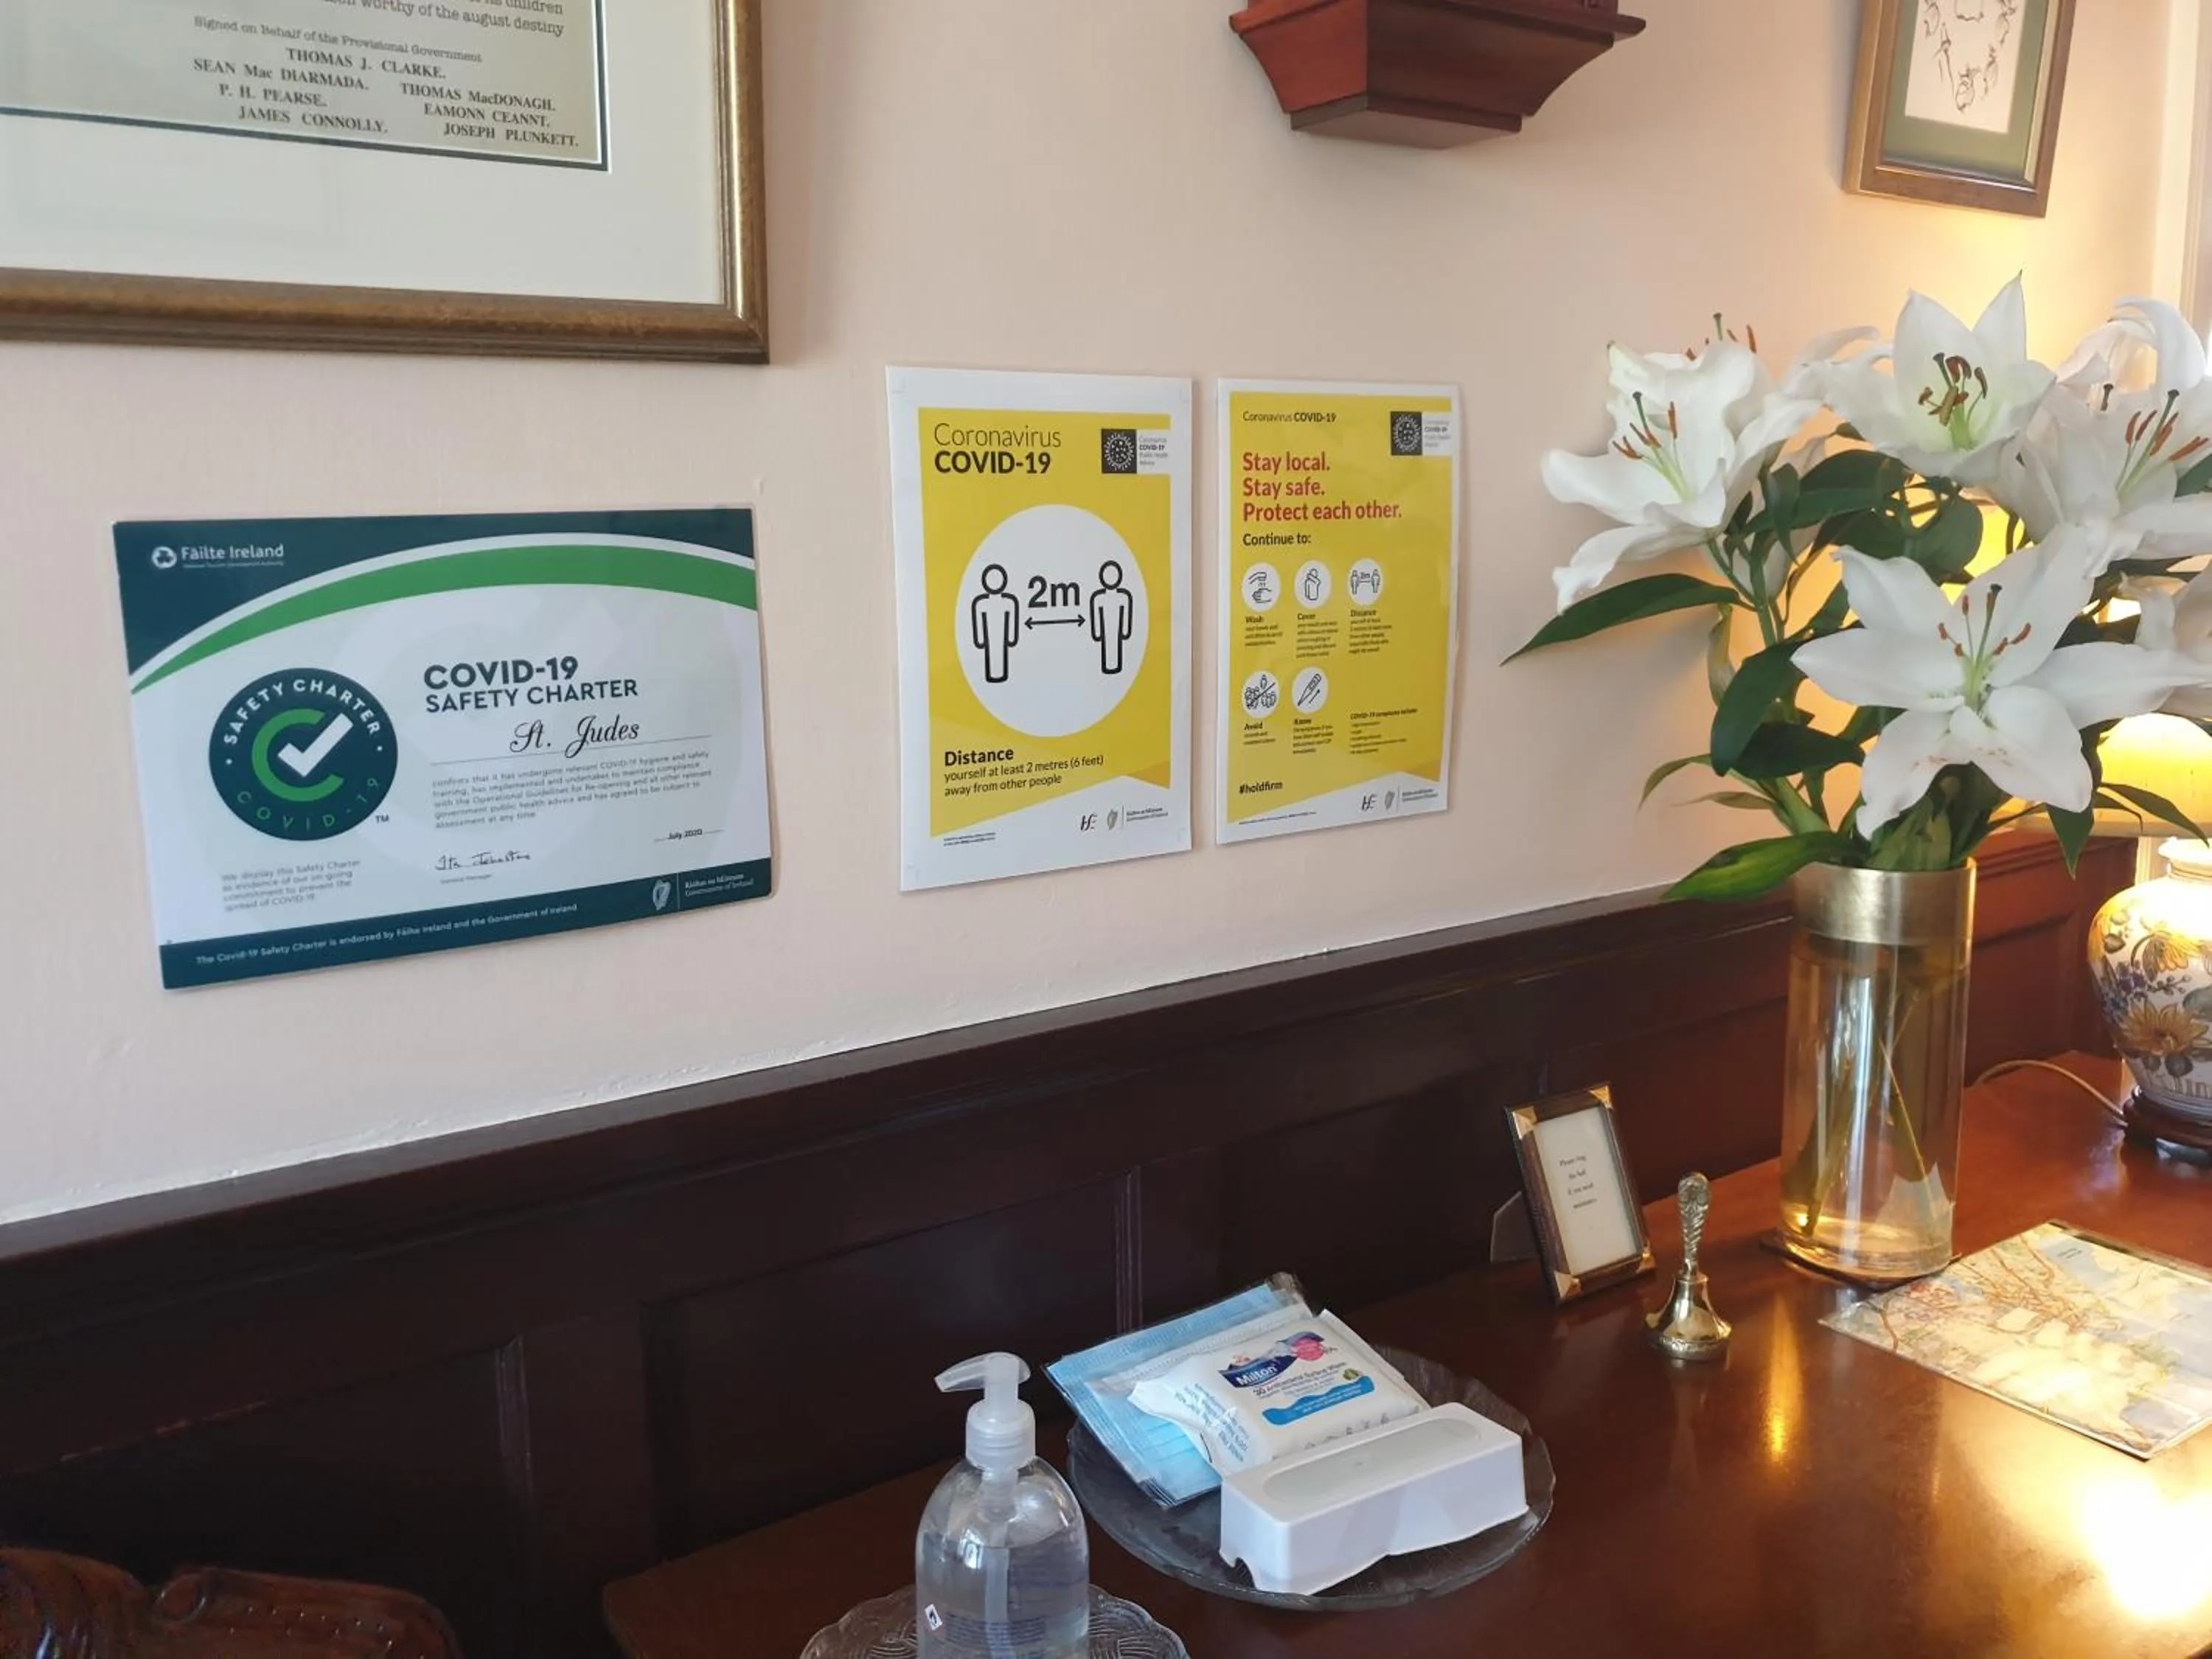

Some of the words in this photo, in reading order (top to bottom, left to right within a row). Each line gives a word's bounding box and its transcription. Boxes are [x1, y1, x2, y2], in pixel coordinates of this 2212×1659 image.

[418, 5, 434, 16] of
[436, 7, 459, 21] the
[463, 12, 510, 27] august
[514, 16, 564, 37] destiny
[195, 15, 237, 31] Signed
[240, 24, 257, 34] on
[342, 35, 408, 54] Provisional
[194, 58, 235, 74] SEAN
[244, 64, 272, 79] Mac
[282, 69, 369, 90] DIARMADA.
[286, 47, 353, 67] THOMAS
[359, 58, 372, 70] J.
[382, 60, 446, 79] CLARKE.
[219, 83, 232, 97] P.
[240, 85, 256, 99] H.
[263, 88, 327, 107] PEARSE.
[401, 83, 462, 100] THOMAS
[469, 90, 555, 111] MacDONAGH.
[239, 106, 290, 123] JAMES
[302, 114, 389, 133] CONNOLLY.
[424, 103, 485, 120] EAMONN
[493, 111, 550, 128] CEANNT.
[444, 122, 495, 139] JOSEPH
[506, 129, 579, 147] PLUNKETT.
[1242, 411, 1292, 422] Coronavirus
[1294, 412, 1336, 422] COVID-19
[933, 422, 1062, 447] Coronavirus
[934, 451, 1051, 474] COVID-19
[1242, 451, 1281, 475] Stay
[1286, 451, 1330, 471] local.
[1242, 478, 1281, 499] Stay
[1286, 476, 1326, 496] safe.
[1242, 501, 1309, 521] Protect
[1312, 500, 1352, 520] each
[1355, 500, 1402, 519] other.
[230, 543, 285, 559] Ireland
[1242, 532, 1294, 546] Continue
[1297, 532, 1312, 544] to:
[1027, 575, 1080, 608] 2m
[423, 655, 579, 690] COVID-19
[425, 688, 518, 714] SAFETY
[526, 678, 639, 705] CHARTER
[224, 681, 284, 745] SAFETY
[293, 678, 381, 735] CHARTER
[564, 713, 640, 759] Judes
[944, 748, 1015, 767] Distance
[944, 766, 986, 783] yourself
[989, 768, 998, 776] at
[1001, 764, 1024, 776] least
[1026, 762, 1032, 773] 2
[1034, 759, 1068, 772] metres
[1071, 757, 1080, 769] (6
[1082, 754, 1105, 767] feet)
[945, 786, 970, 797] away
[973, 781, 997, 793] from
[1000, 779, 1026, 790] other
[1029, 774, 1062, 788] people
[1239, 780, 1284, 795] #holdfirm
[237, 778, 379, 832] COVID-19
[375, 815, 390, 824] TM
[667, 832, 682, 841] July
[196, 955, 215, 964] The
[261, 945, 291, 956] Safety
[293, 939, 327, 952] Charter
[1235, 1364, 1278, 1385] Milton
